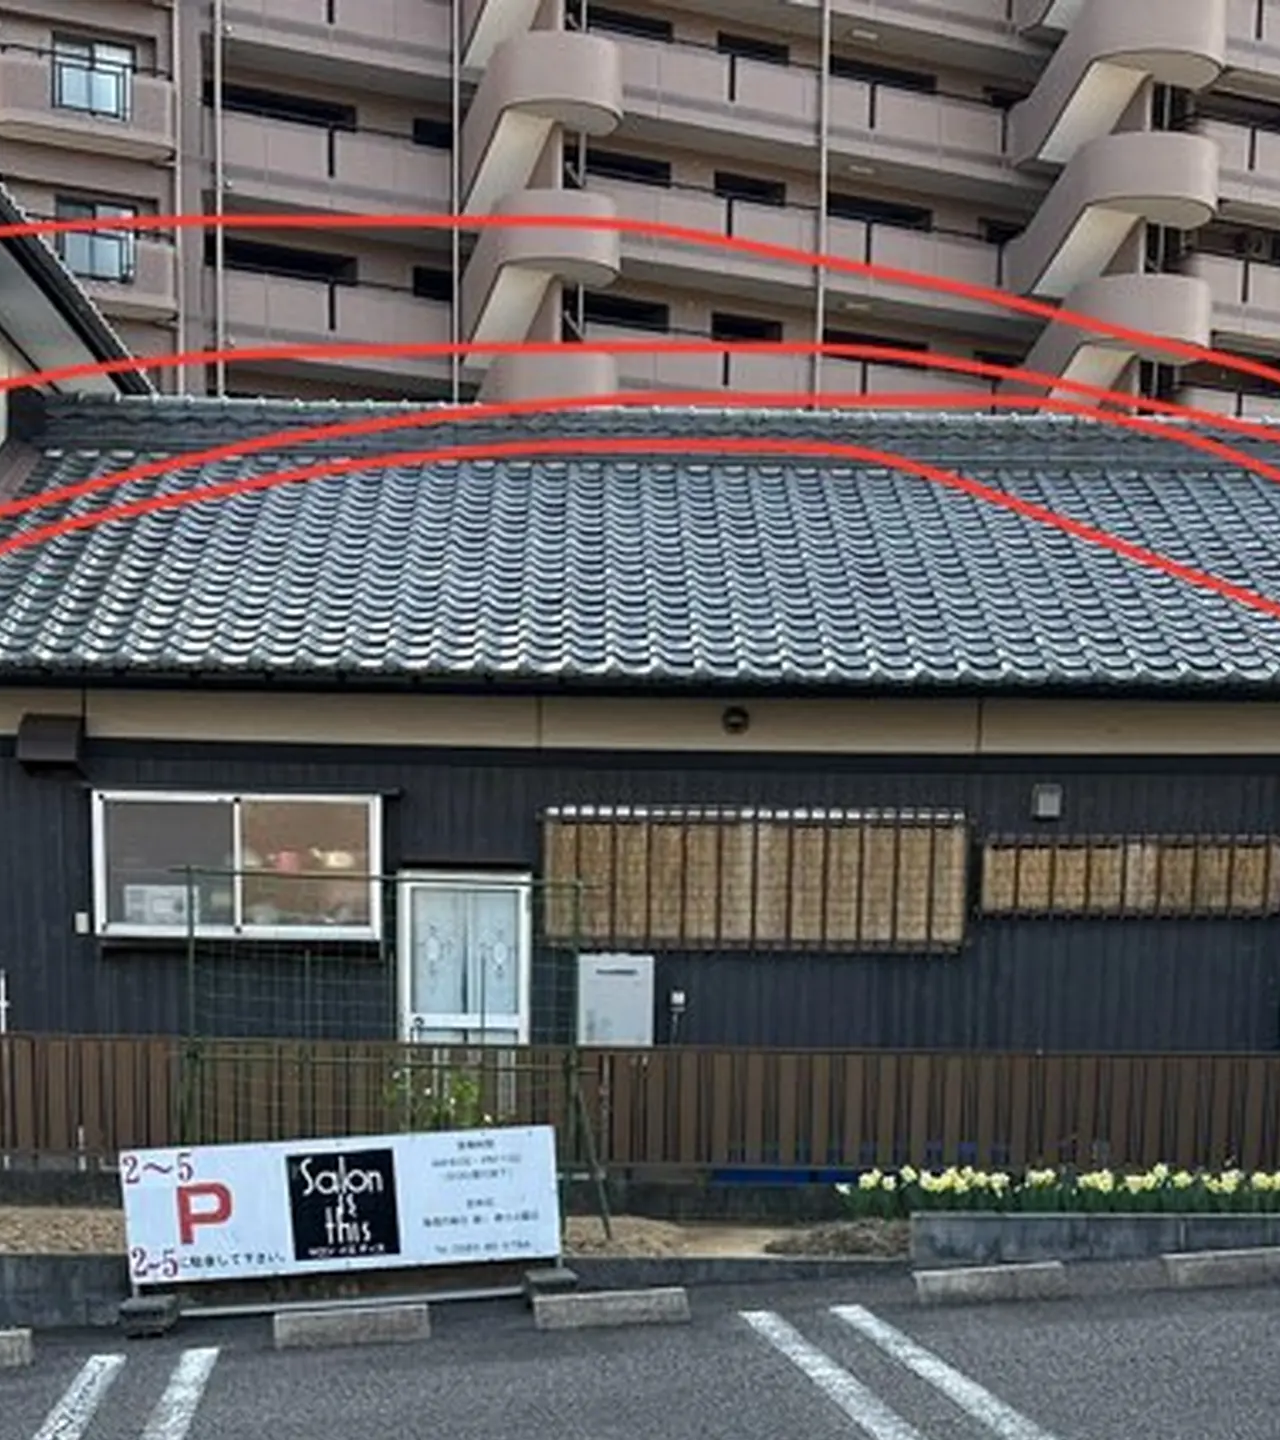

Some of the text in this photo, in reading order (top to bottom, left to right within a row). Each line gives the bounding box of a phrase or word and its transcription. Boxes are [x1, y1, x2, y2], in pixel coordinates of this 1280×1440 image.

[299, 1156, 384, 1197] Salon
[176, 1181, 233, 1245] P
[324, 1206, 371, 1244] this
[336, 1193, 358, 1218] is
